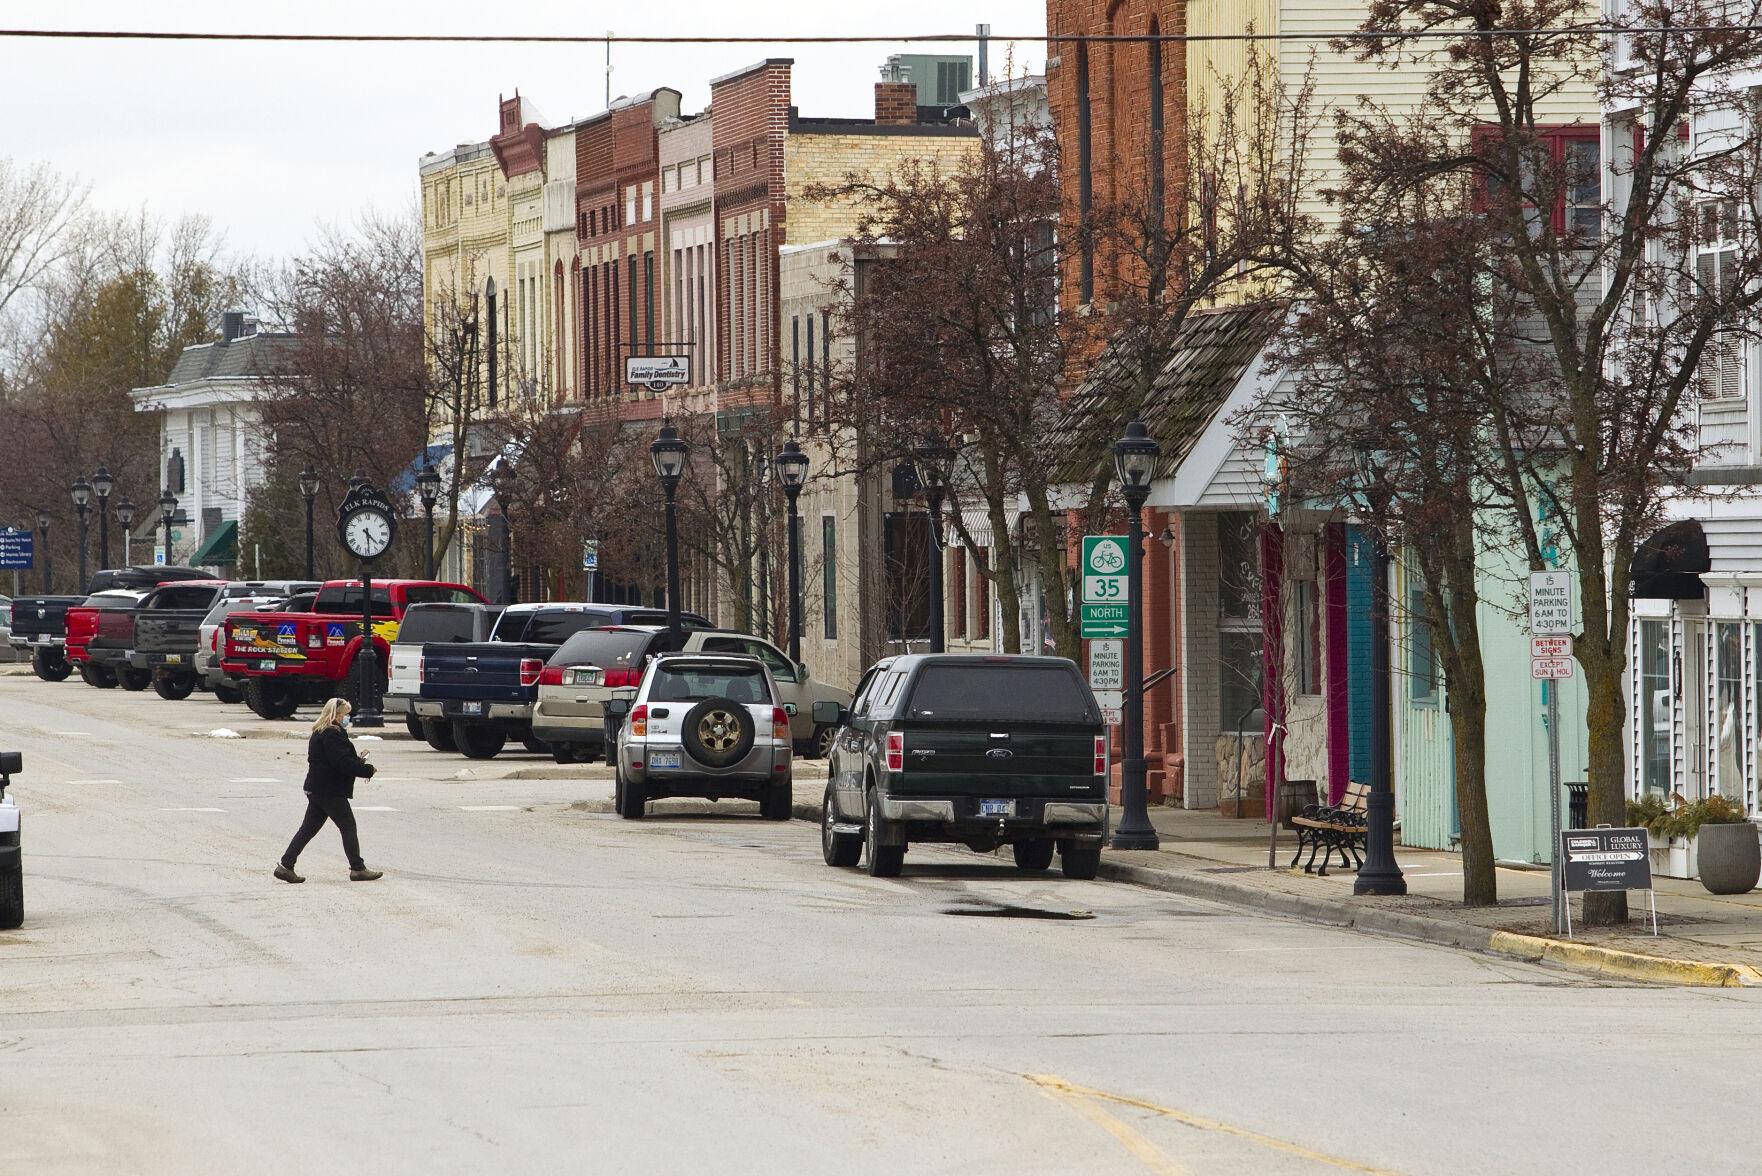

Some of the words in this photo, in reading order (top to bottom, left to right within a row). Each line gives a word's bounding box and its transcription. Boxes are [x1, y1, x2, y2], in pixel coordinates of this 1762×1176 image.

[630, 371, 654, 380] Family
[654, 370, 686, 379] Dentistry
[345, 501, 360, 512] ELK
[362, 498, 390, 512] RAPIDS
[1546, 577, 1554, 585] 15
[1095, 579, 1120, 597] 35
[1535, 588, 1565, 596] MINUTE
[1534, 599, 1568, 607] PARKING
[1090, 608, 1123, 618] NORTH
[1587, 868, 1626, 878] Welcome
